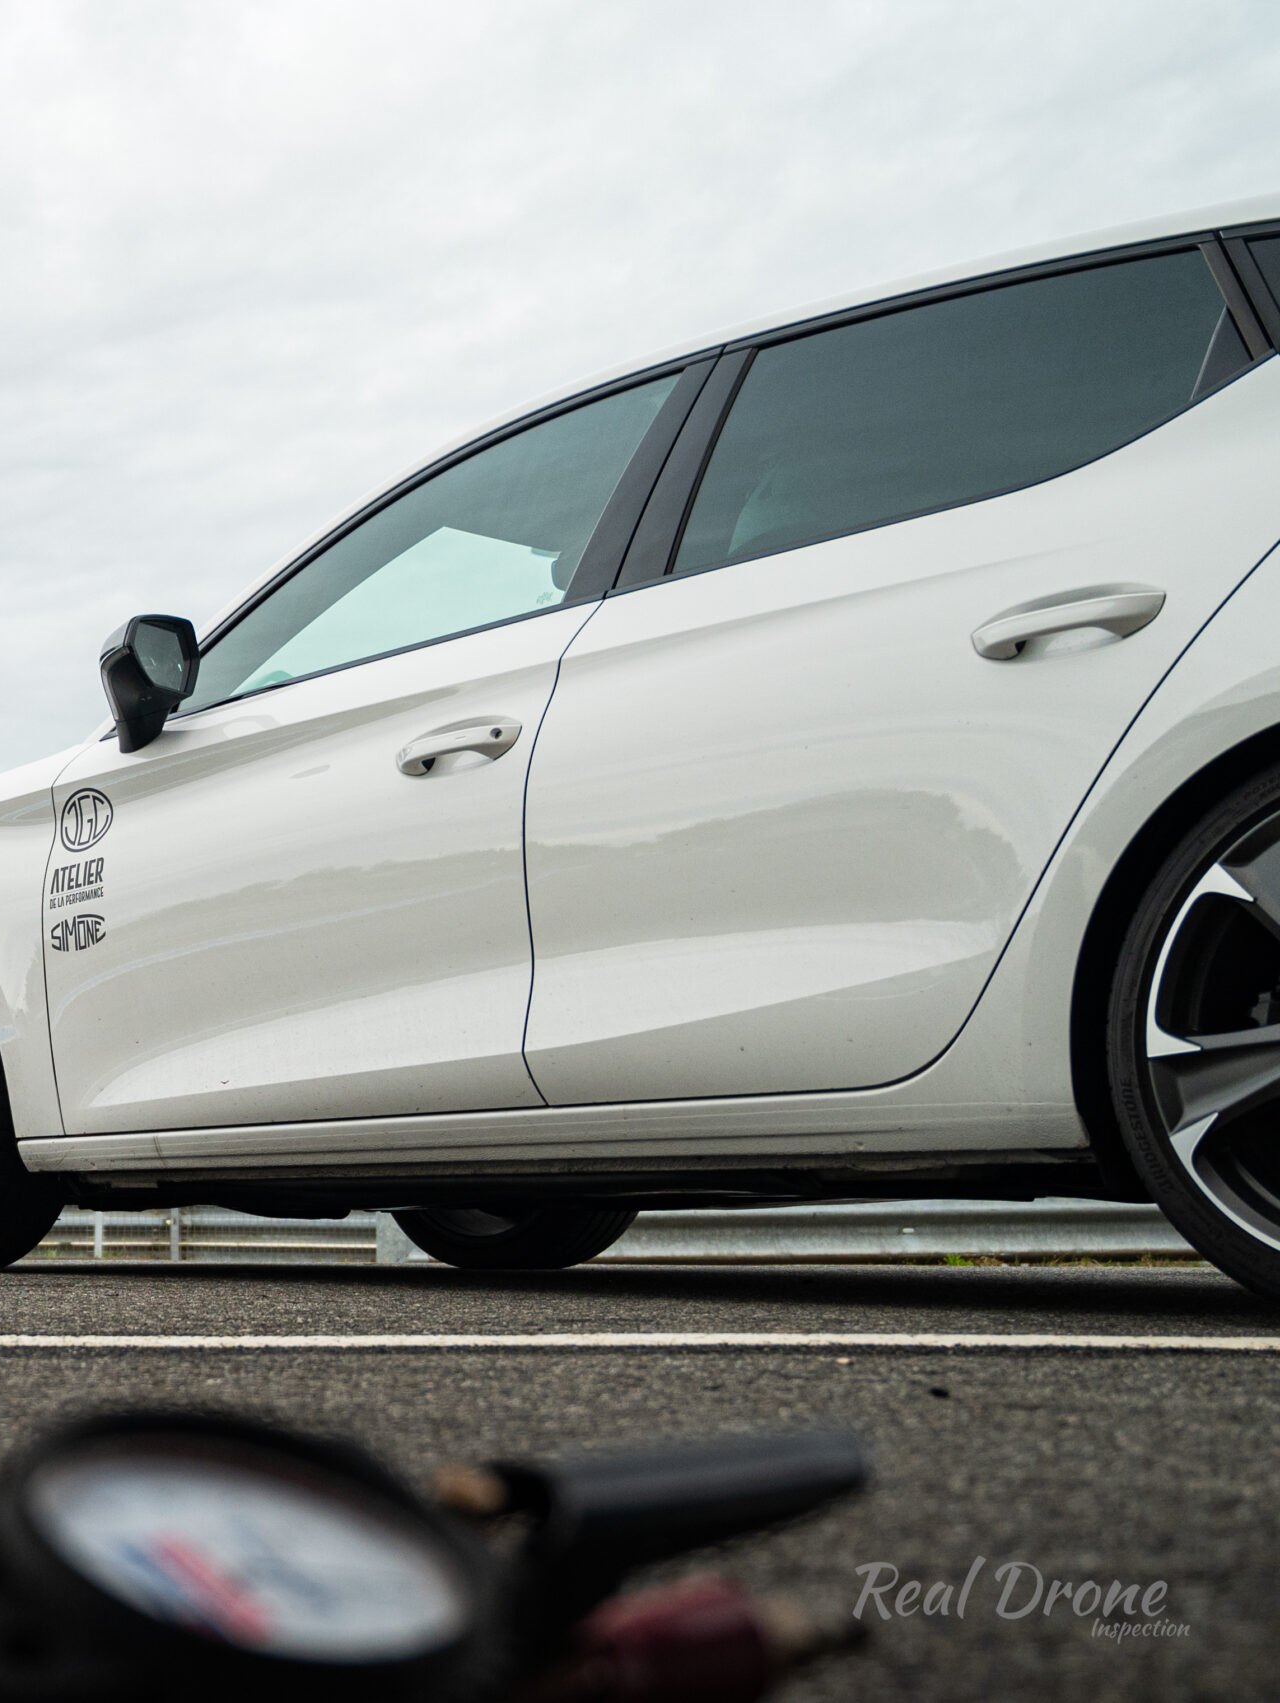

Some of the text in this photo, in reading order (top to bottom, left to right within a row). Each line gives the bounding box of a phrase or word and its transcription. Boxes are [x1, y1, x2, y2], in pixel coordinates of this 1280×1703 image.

[50, 857, 105, 895] ATELIER
[49, 886, 104, 910] DE LA PERFORMANCE
[50, 913, 107, 952] SIMONE
